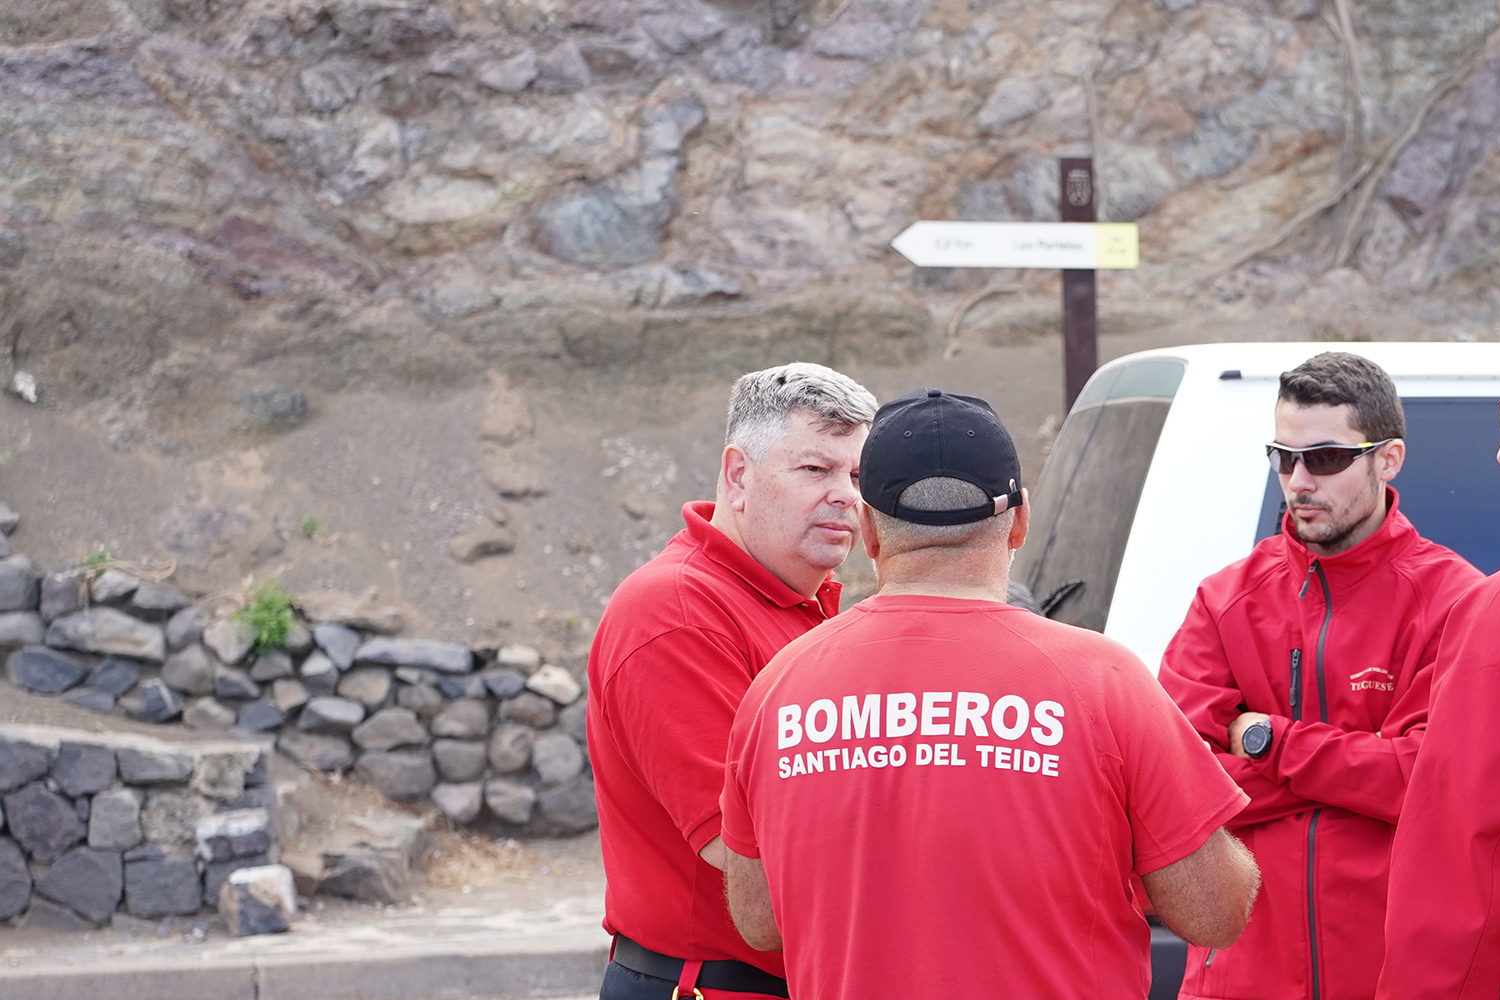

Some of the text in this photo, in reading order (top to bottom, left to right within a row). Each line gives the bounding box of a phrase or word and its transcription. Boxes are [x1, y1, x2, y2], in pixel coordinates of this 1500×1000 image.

[1350, 680, 1394, 692] TEGUESE
[778, 691, 1065, 750] BOMBEROS
[778, 743, 1060, 779] SANTIAGO DEL TEIDE
